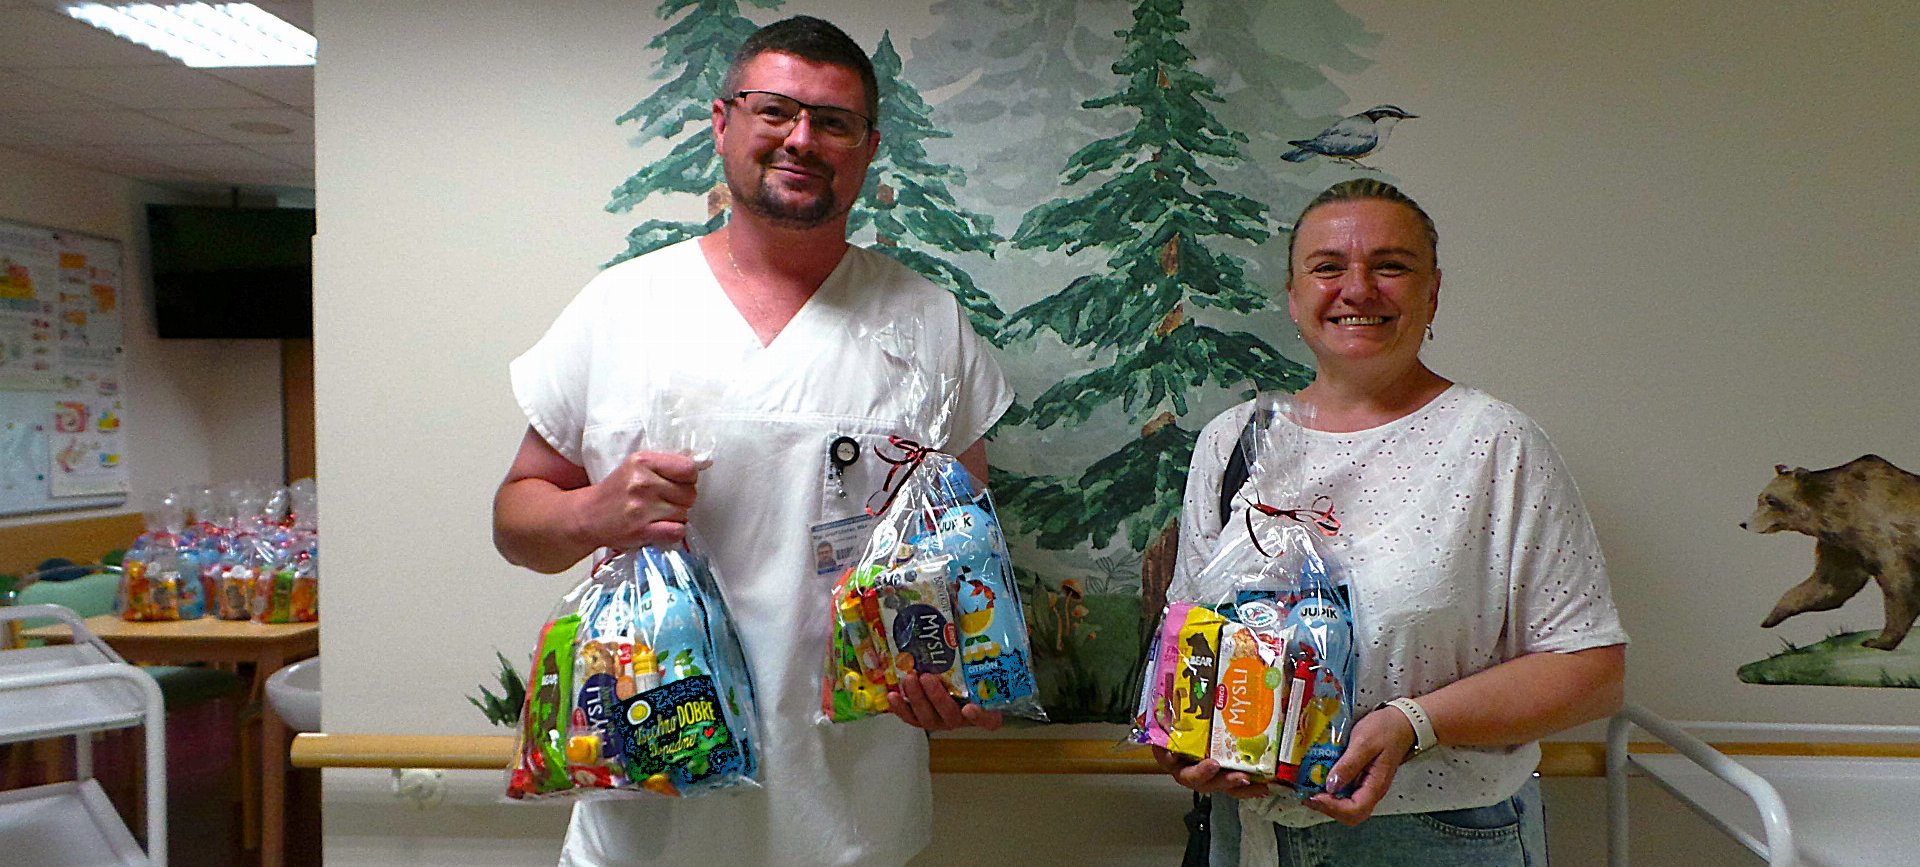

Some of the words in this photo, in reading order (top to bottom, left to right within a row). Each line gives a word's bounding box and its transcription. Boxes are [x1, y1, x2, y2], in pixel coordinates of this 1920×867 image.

[919, 614, 948, 664] MYSLI
[1189, 655, 1213, 668] BEAR
[1216, 685, 1225, 709] Emco
[1229, 668, 1251, 725] MYSLI
